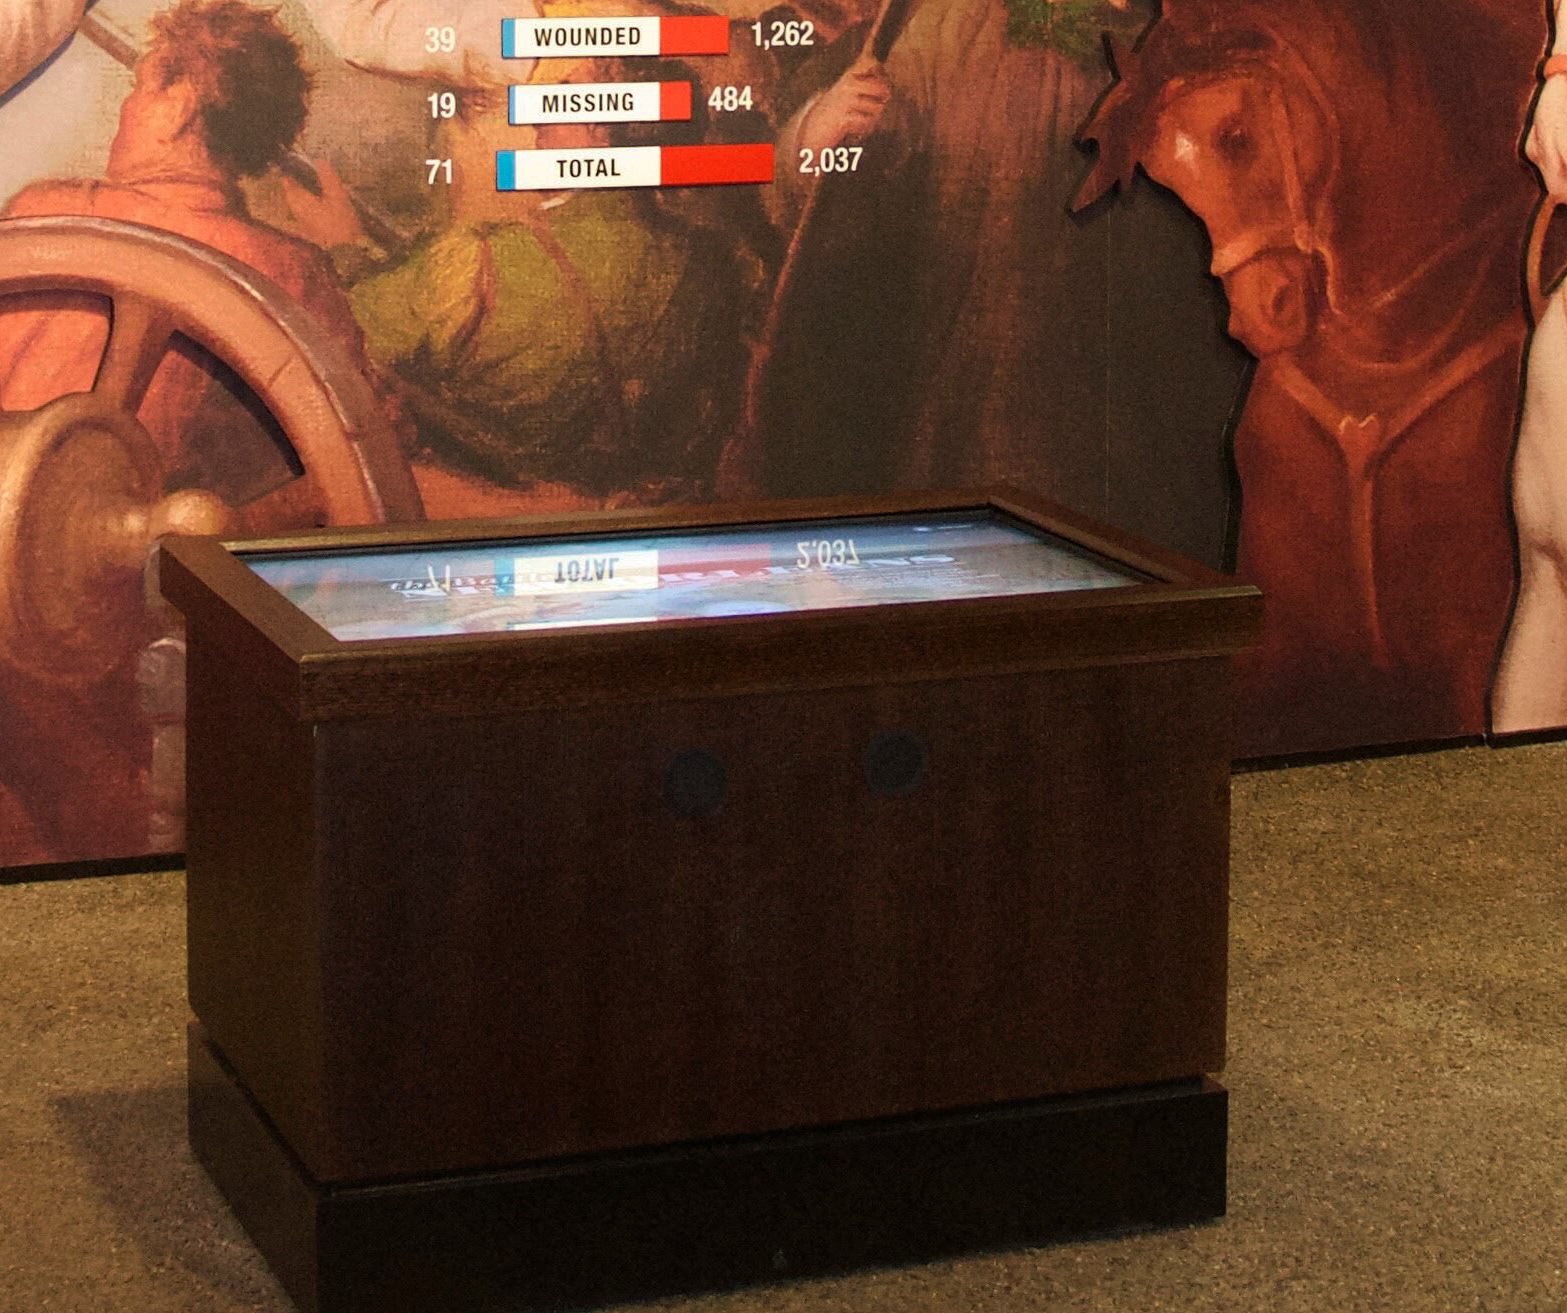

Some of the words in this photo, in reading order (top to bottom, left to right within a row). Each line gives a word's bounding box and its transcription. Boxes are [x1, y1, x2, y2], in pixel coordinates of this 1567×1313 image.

[424, 26, 456, 54] 39
[533, 26, 643, 49] WOUNDED
[750, 19, 815, 53] 1,262
[426, 92, 457, 120] 19
[541, 91, 635, 115] MISSING
[707, 84, 755, 113] 484
[424, 158, 454, 186] 71
[555, 157, 623, 180] TOTAL
[798, 146, 865, 179] 2,037
